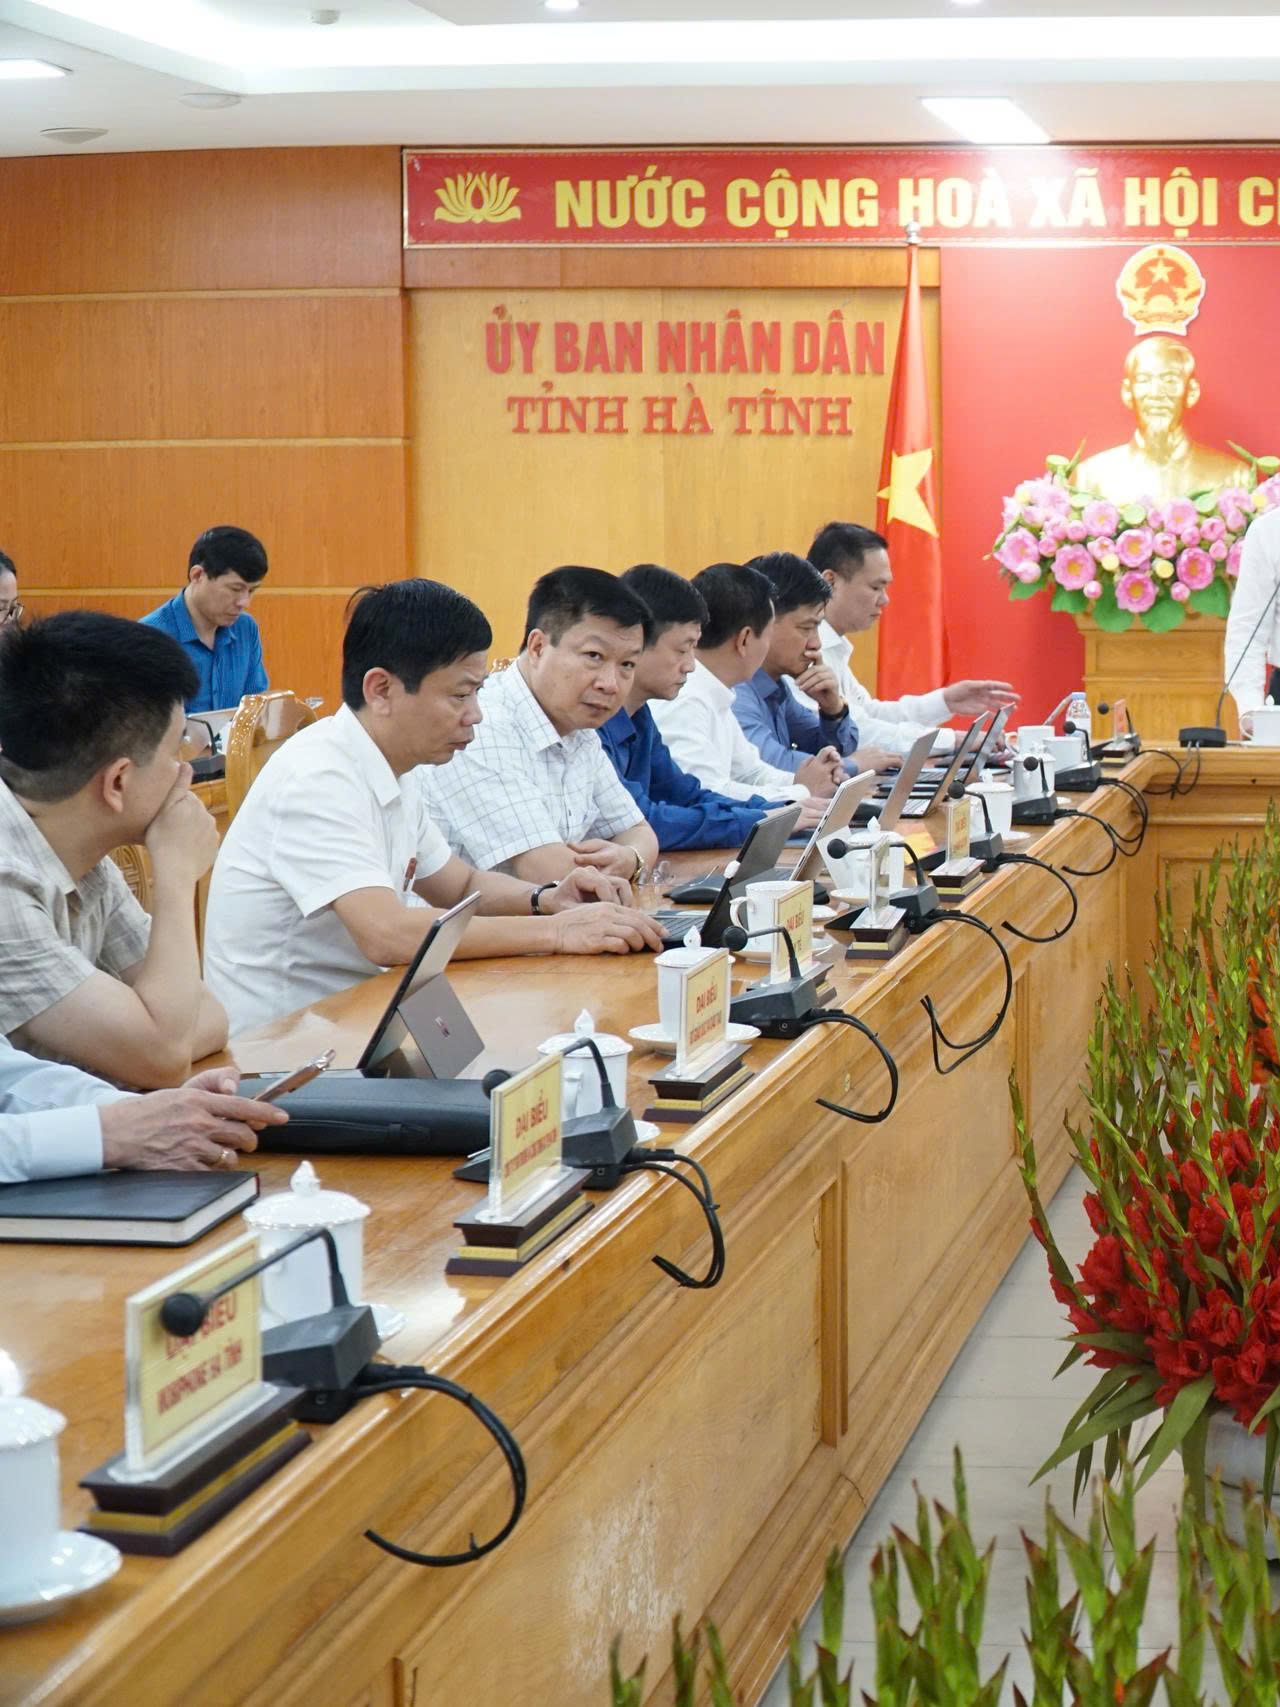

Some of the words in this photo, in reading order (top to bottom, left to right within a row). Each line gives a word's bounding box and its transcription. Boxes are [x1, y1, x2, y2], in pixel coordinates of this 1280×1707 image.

[555, 165, 706, 228] NƯỚC
[726, 168, 879, 238] CỘNG
[899, 167, 1016, 229] HOÀ
[1030, 168, 1107, 228] XÃ
[1125, 167, 1218, 237] HỘI
[485, 304, 540, 374] ỦY
[554, 321, 644, 374] BAN
[658, 309, 782, 375] NHÂN
[794, 309, 885, 375] DÂN
[506, 381, 630, 434] TỈNH
[642, 383, 714, 435] HÀ
[728, 388, 853, 436] TĨNH
